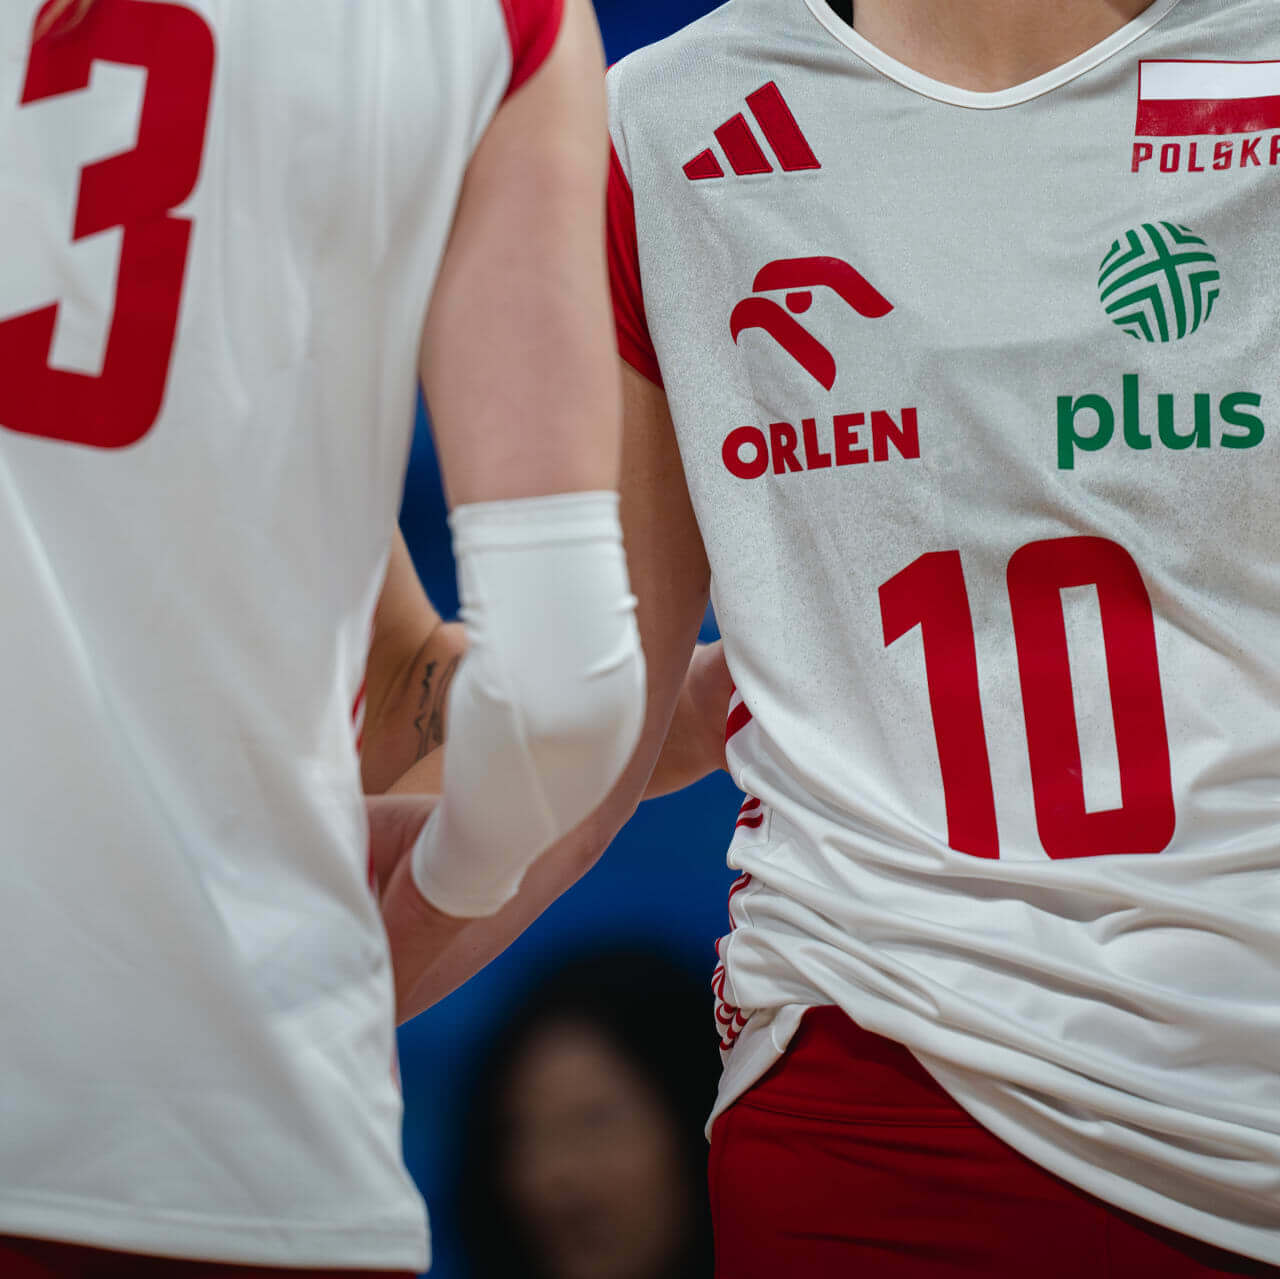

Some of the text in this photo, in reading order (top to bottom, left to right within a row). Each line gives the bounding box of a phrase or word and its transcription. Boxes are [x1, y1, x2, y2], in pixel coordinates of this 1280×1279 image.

[721, 407, 921, 480] ORLEN
[1057, 373, 1265, 470] plus
[877, 535, 1177, 861] 10
